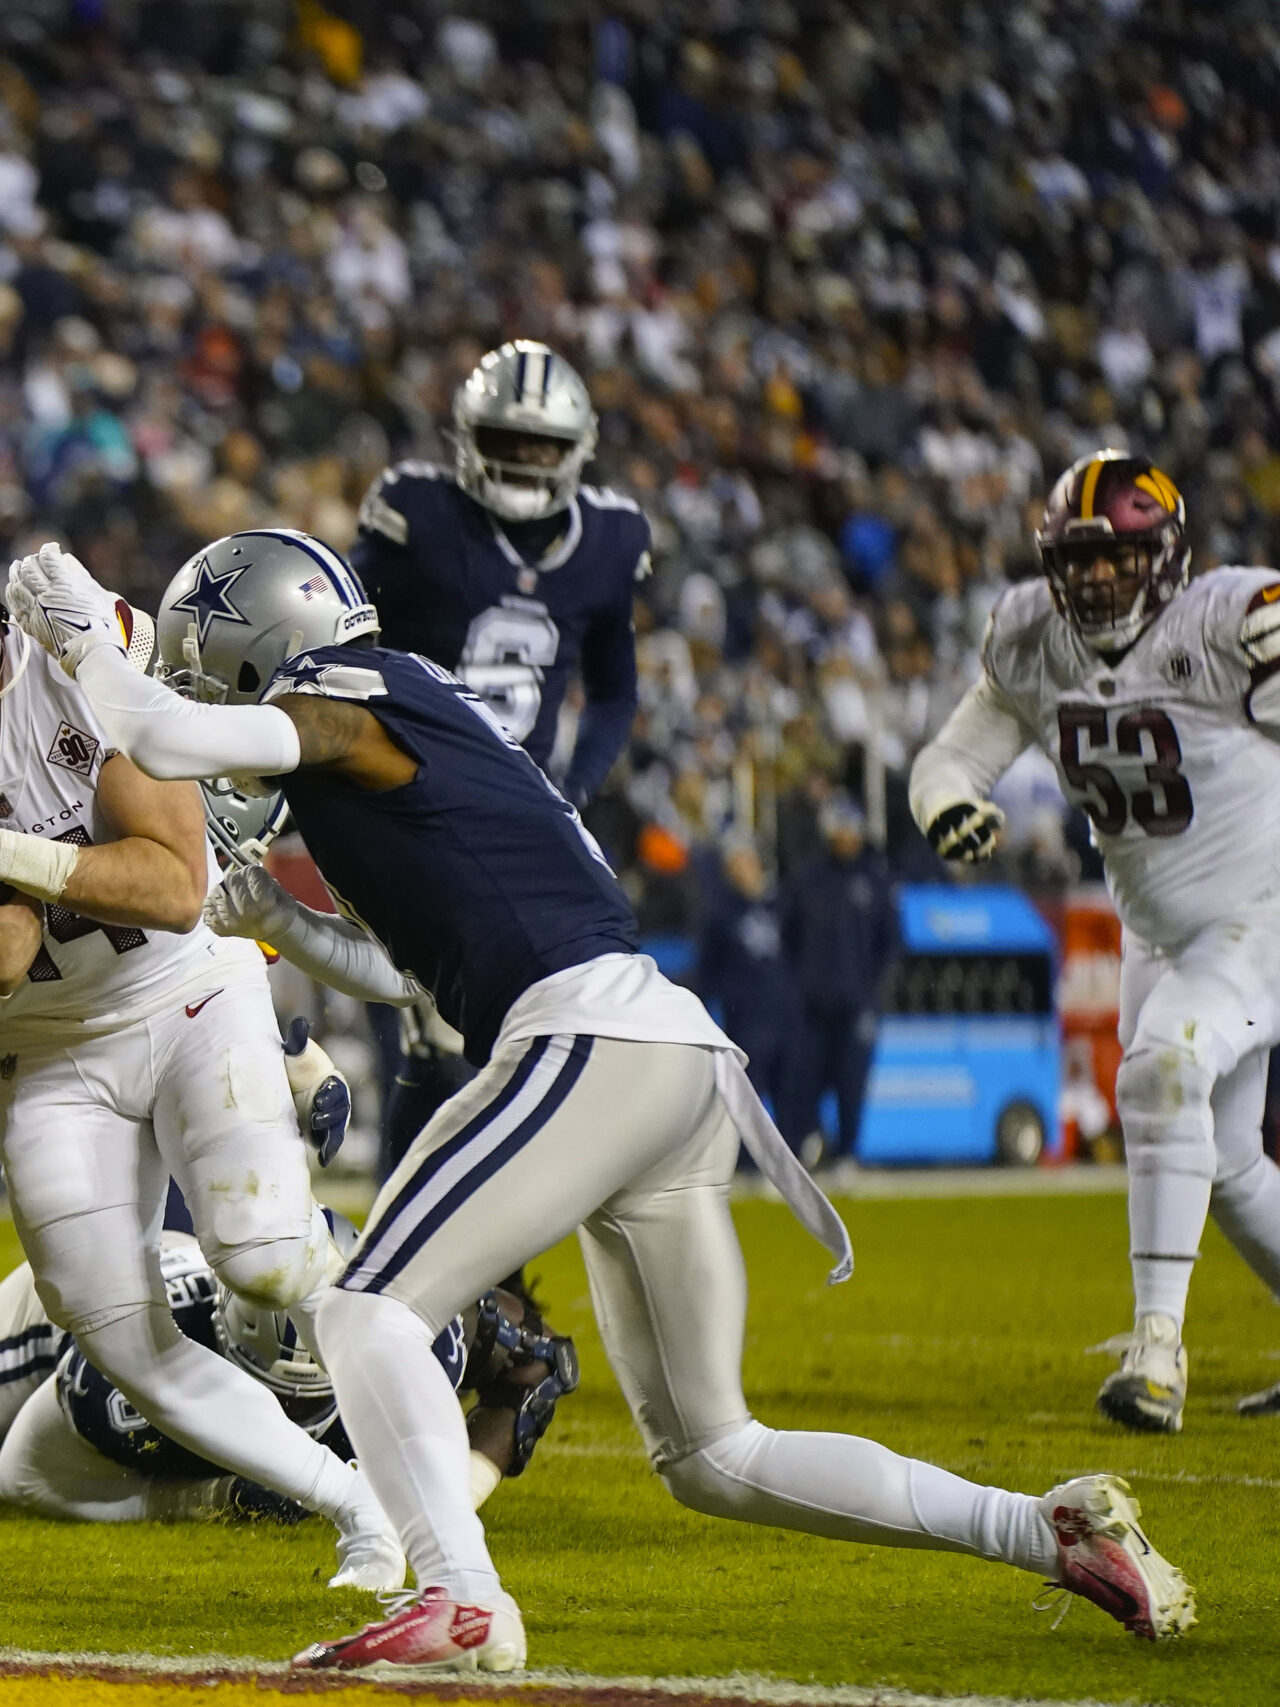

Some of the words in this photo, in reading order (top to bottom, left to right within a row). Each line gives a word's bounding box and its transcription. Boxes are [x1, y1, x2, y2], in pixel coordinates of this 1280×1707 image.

[58, 733, 91, 766] 90
[1057, 703, 1194, 837] 53
[23, 800, 84, 834] GTON
